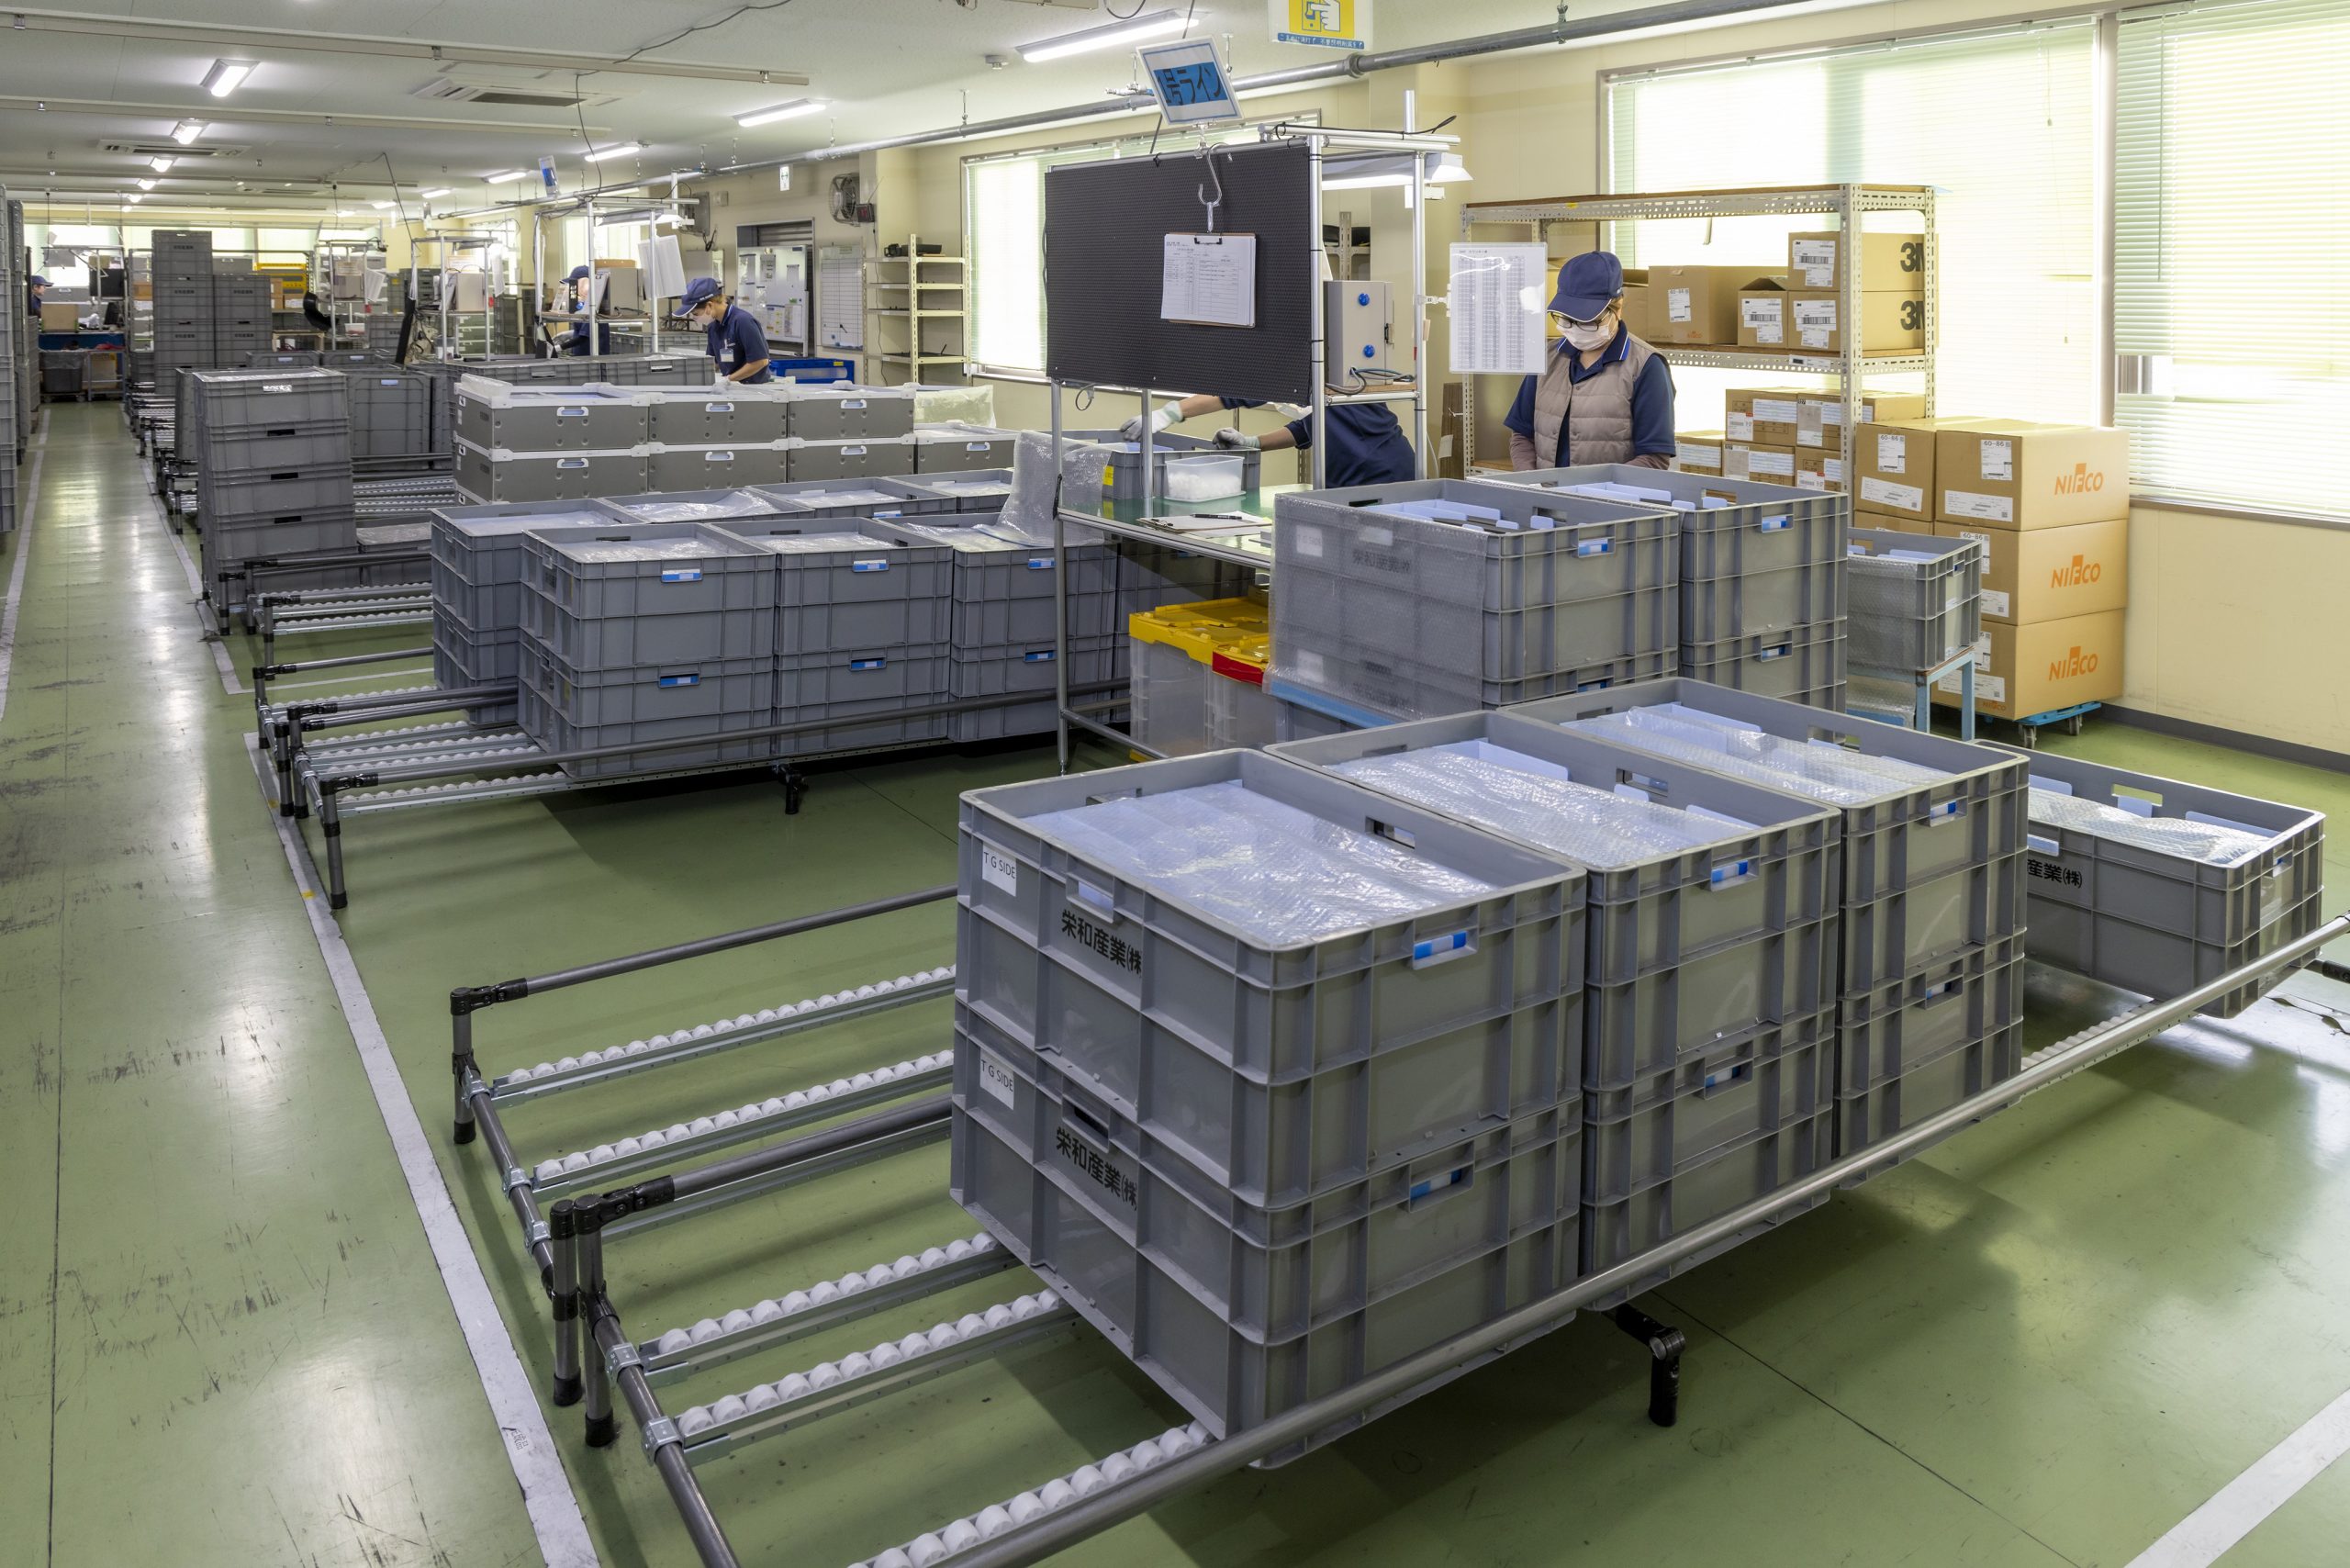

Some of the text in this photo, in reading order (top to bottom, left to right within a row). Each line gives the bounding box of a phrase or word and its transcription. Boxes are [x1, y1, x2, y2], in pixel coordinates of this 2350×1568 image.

[2054, 463, 2104, 495] NIFCO
[2051, 554, 2101, 588] NIFCO
[2049, 645, 2098, 681] NIFCO
[998, 860, 1016, 879] SIDE
[1061, 909, 1142, 978] 栄和産業(株
[996, 1068, 1013, 1093] SIDE
